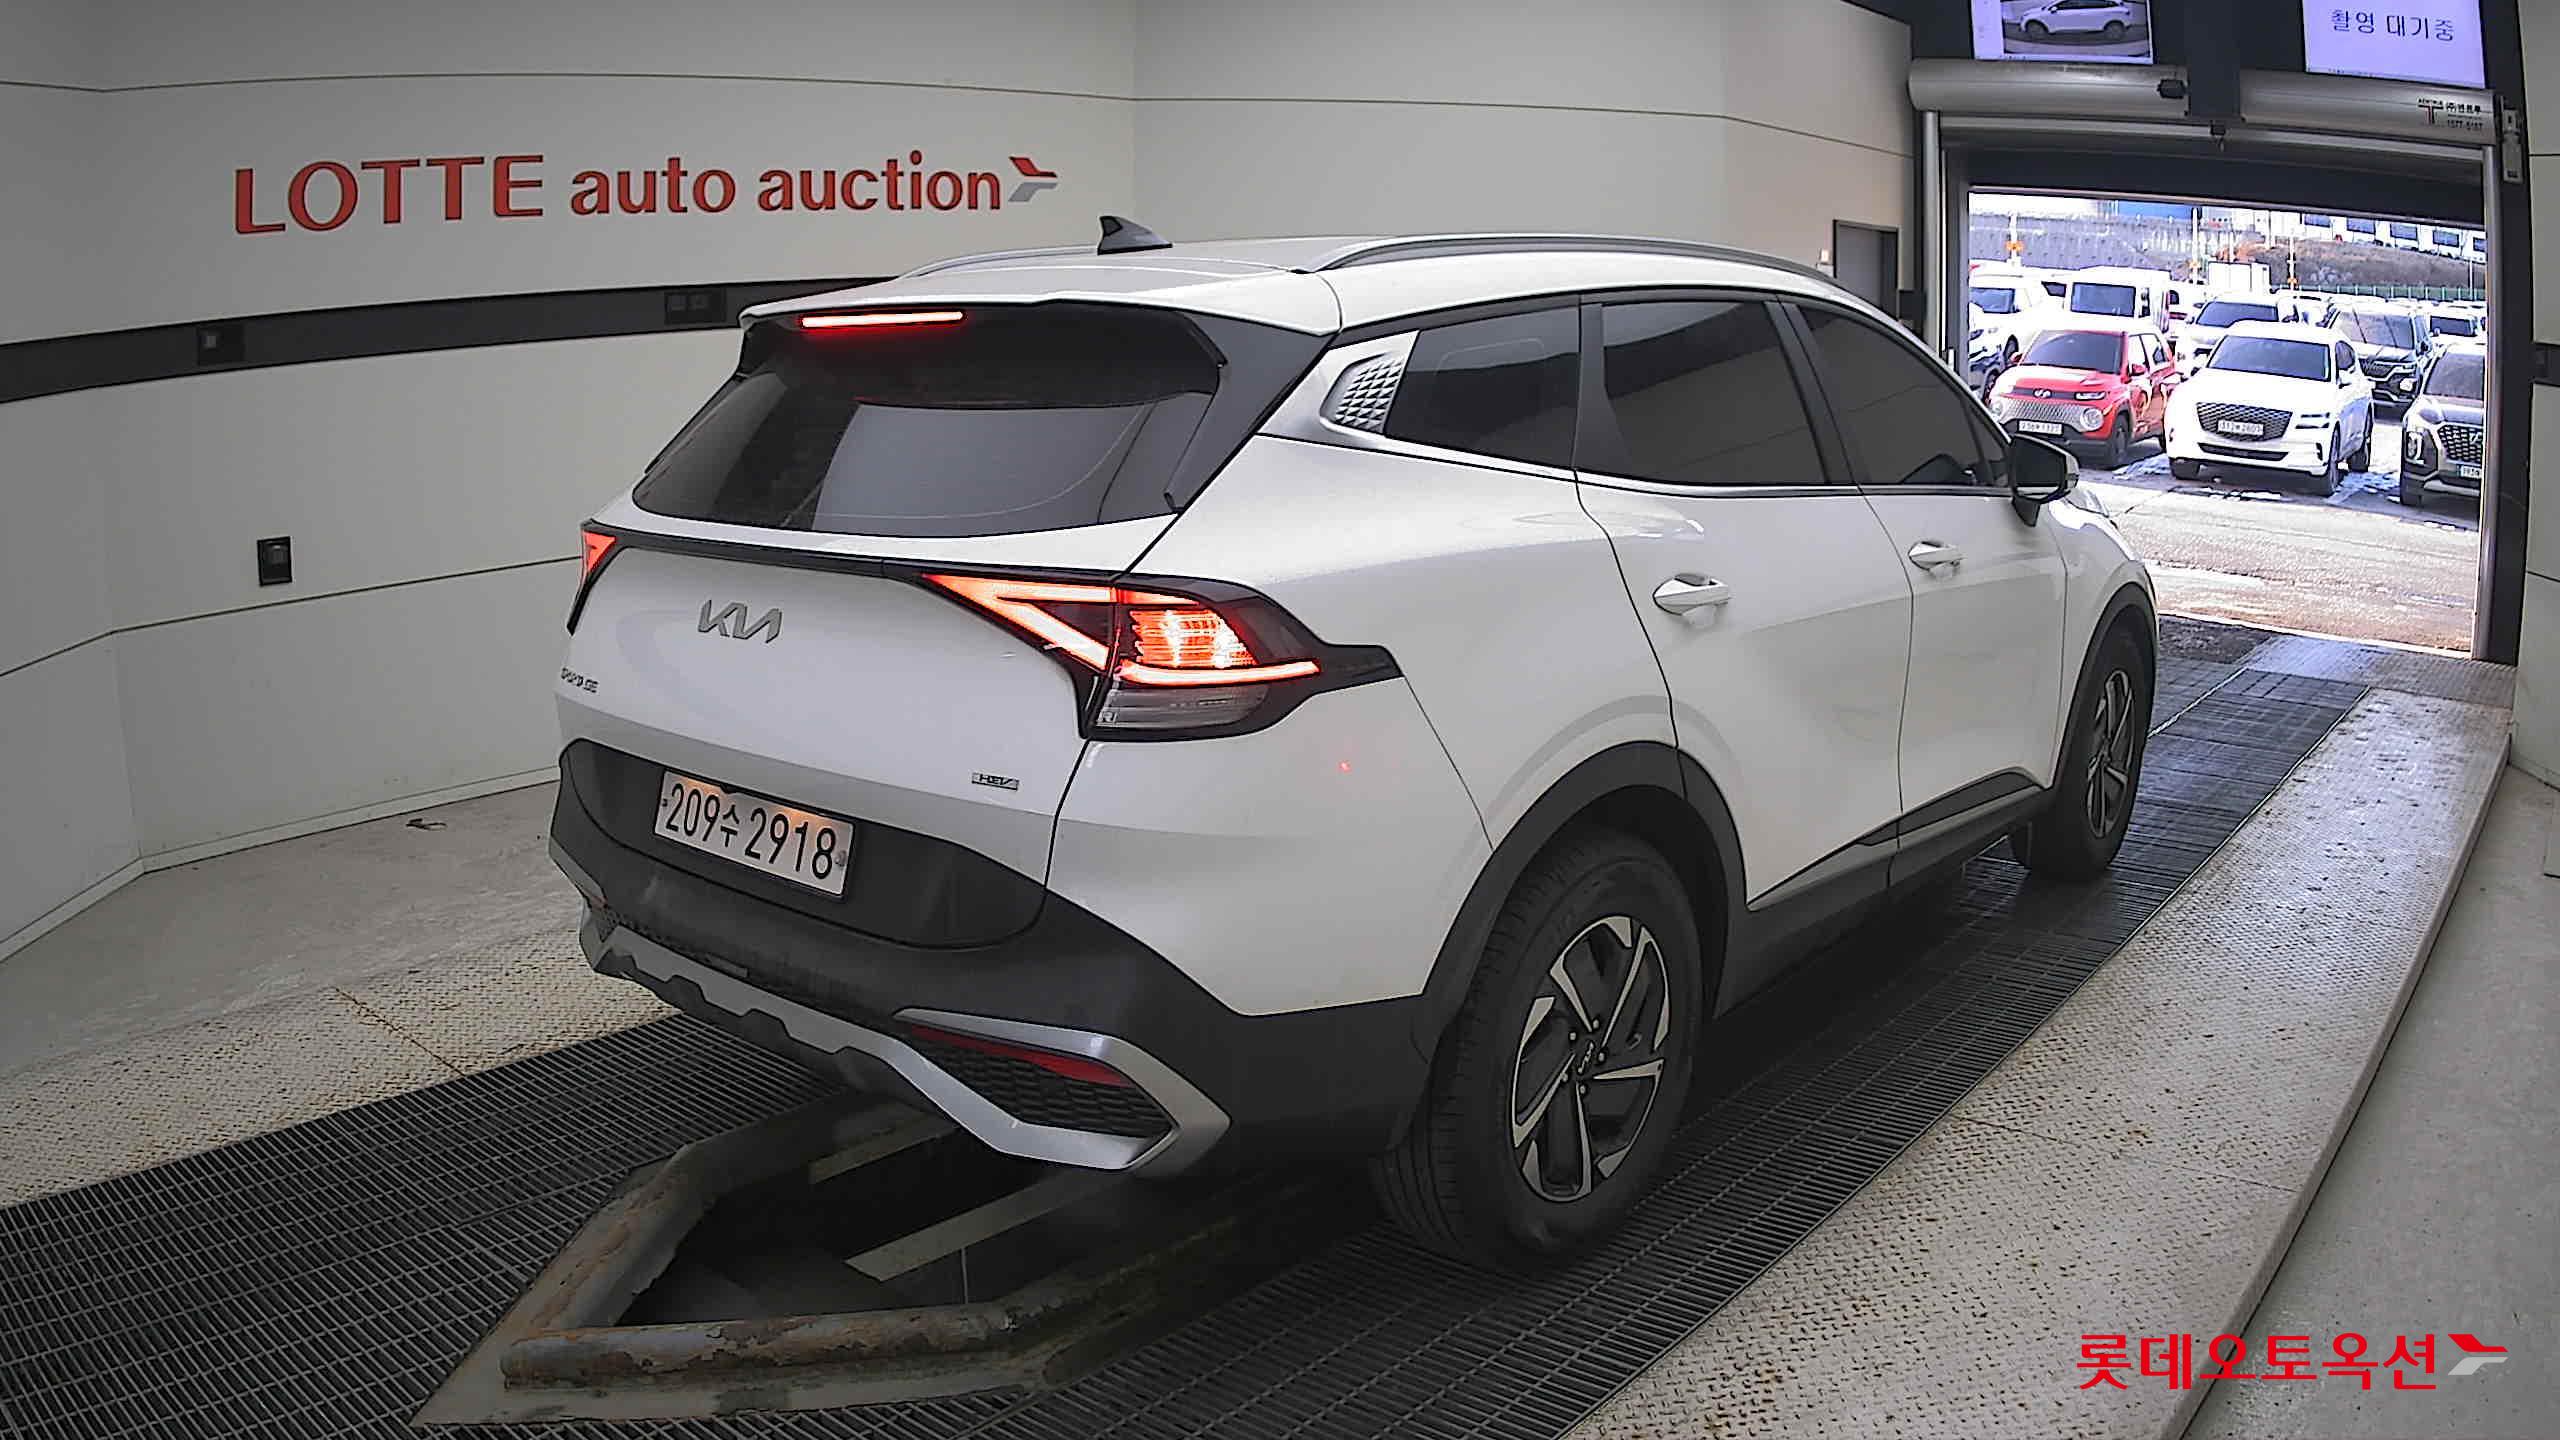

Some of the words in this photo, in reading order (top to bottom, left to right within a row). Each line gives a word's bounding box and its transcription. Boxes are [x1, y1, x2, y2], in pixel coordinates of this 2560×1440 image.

[2331, 9, 2376, 34] 촬영
[2386, 15, 2454, 42] 대기중
[234, 153, 545, 235] LOTTE
[568, 155, 737, 215] auto
[758, 149, 1001, 213] auction
[696, 599, 783, 644] KIA
